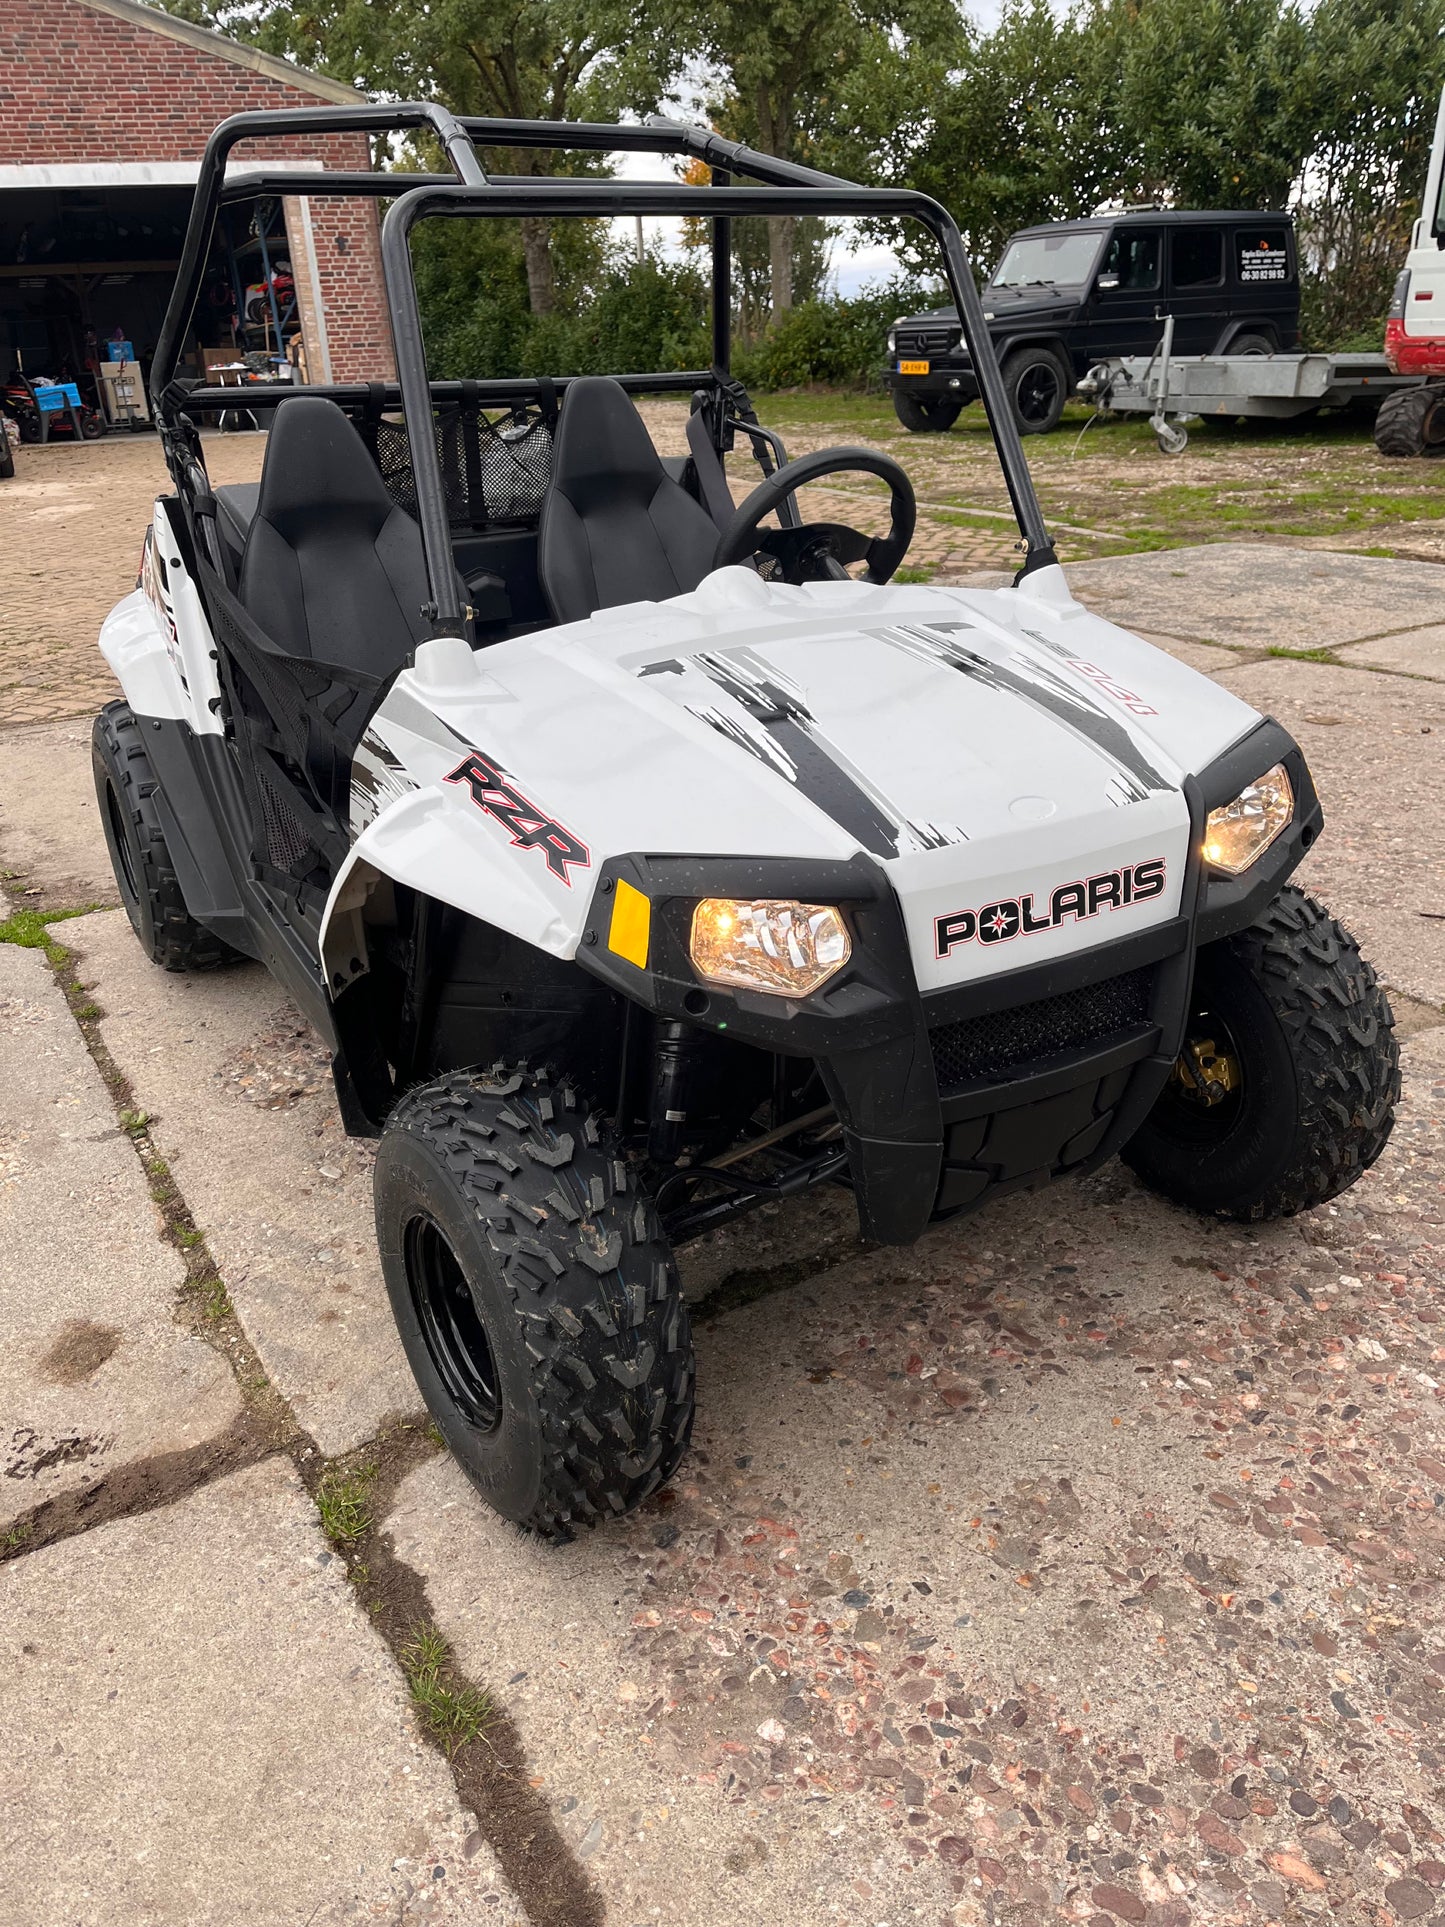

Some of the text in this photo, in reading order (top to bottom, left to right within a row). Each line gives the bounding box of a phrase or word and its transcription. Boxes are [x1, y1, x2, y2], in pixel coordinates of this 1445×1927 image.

[112, 376, 135, 384] JCB
[443, 753, 591, 887] RZR
[934, 857, 1167, 959] POLARIS
